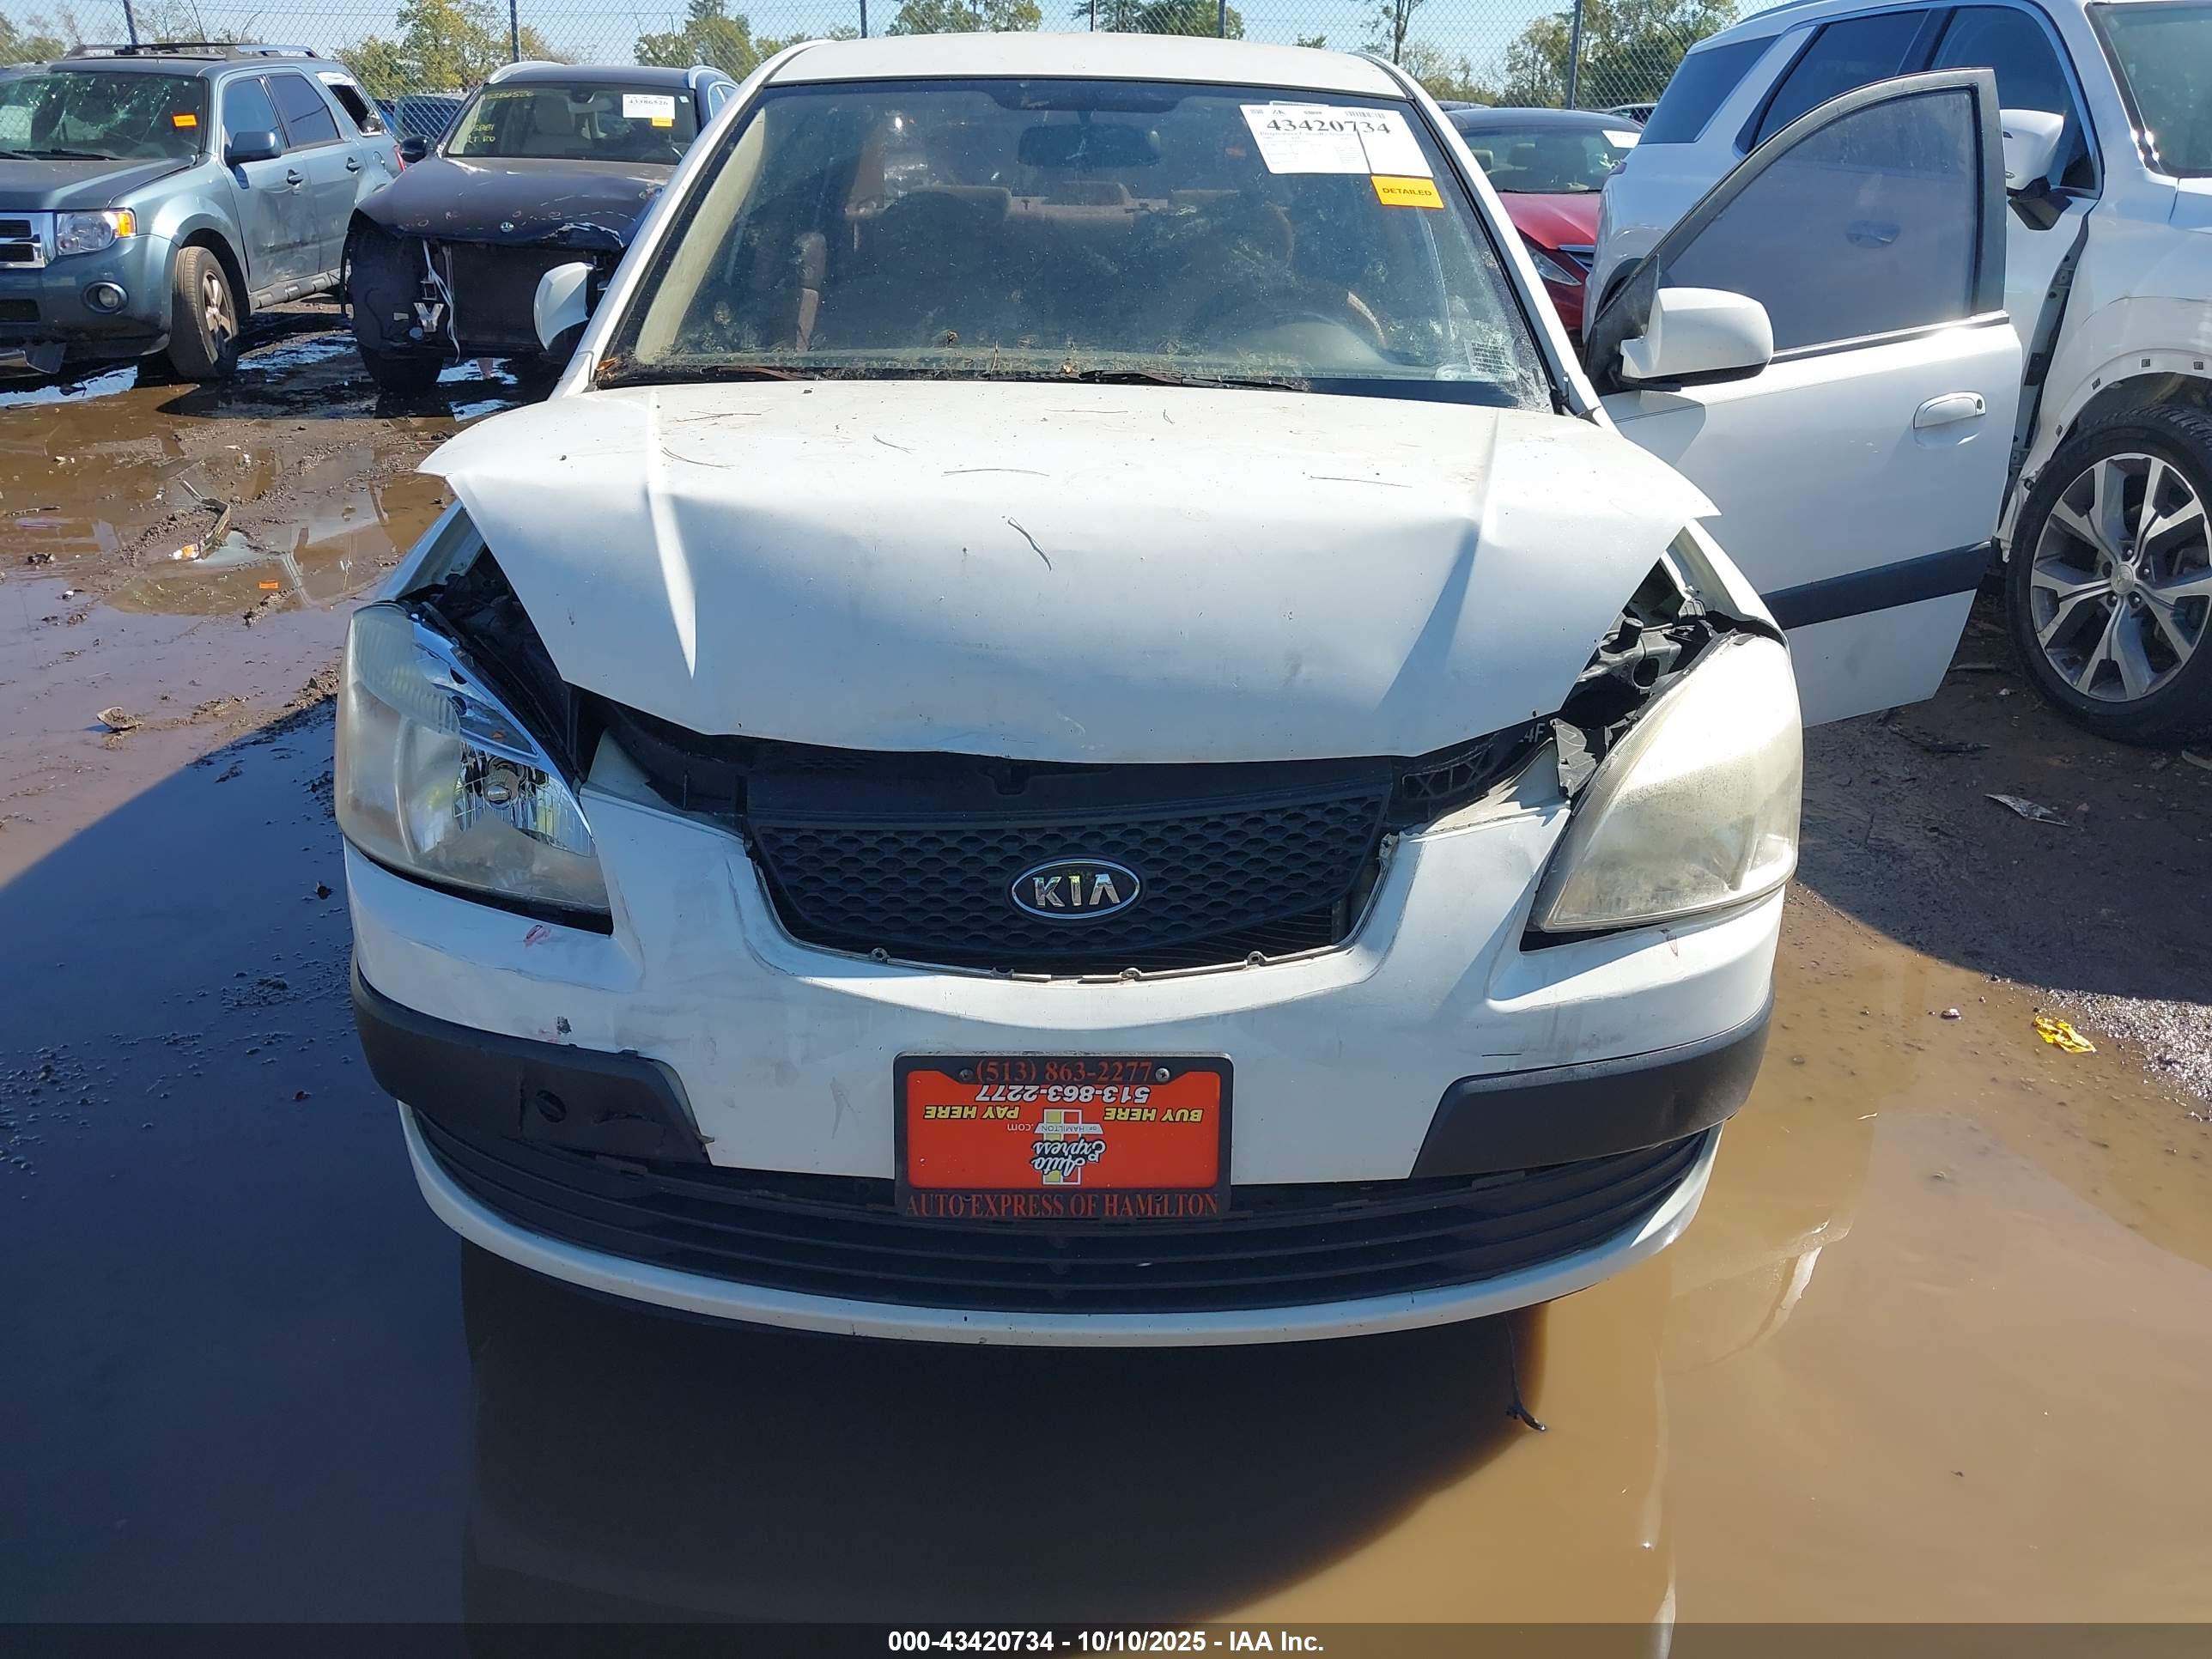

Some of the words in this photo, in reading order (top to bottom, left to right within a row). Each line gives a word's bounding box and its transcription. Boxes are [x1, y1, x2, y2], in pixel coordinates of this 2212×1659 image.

[1267, 119, 1391, 134] 43420734
[1382, 186, 1432, 197] DETAILED
[1032, 872, 1121, 908] KIA
[975, 1060, 1037, 1083] (513)
[1044, 1060, 1153, 1083] 863-2277
[975, 1085, 1152, 1103] 513-863-2277
[923, 1104, 978, 1120] HERE
[981, 1105, 1021, 1120] PAY
[1103, 1107, 1158, 1121] HERE
[1160, 1108, 1204, 1122] BUY
[1006, 1122, 1035, 1132] .com
[1032, 1138, 1107, 1163] Express
[1030, 1154, 1086, 1177] Auto
[906, 1194, 965, 1217] AUTO
[970, 1194, 1065, 1218] EXPRESS
[1069, 1194, 1099, 1218] OF
[1103, 1194, 1219, 1218] HAMILTON
